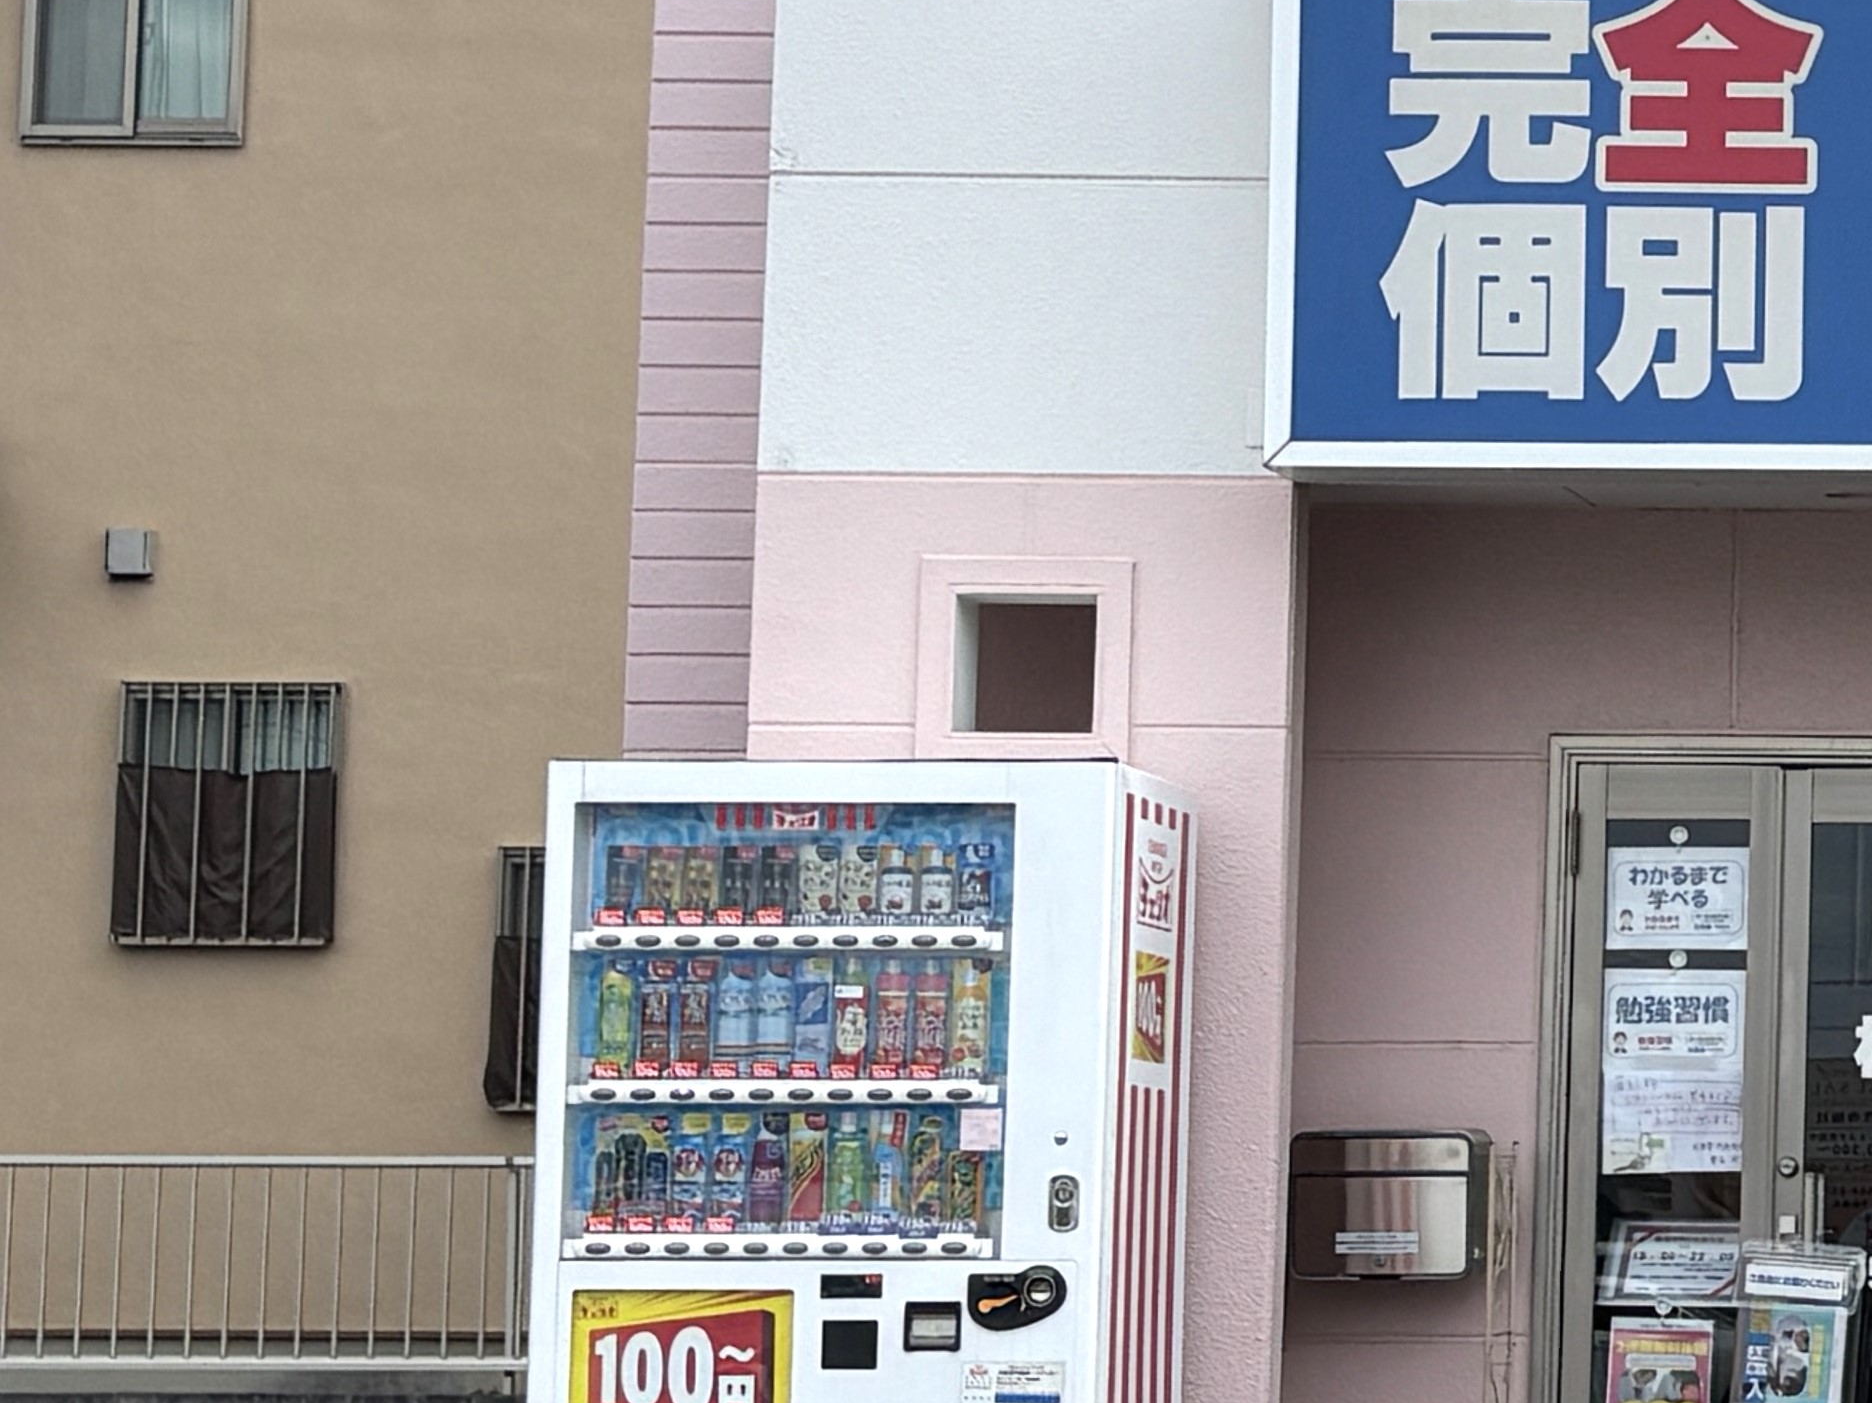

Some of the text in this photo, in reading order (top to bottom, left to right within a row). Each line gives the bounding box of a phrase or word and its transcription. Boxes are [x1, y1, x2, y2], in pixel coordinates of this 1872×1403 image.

[1378, 197, 1805, 402] 個別
[1628, 865, 1729, 887] わかるまで
[1647, 888, 1709, 911] 学べる
[1615, 995, 1730, 1025] 勉強習慣
